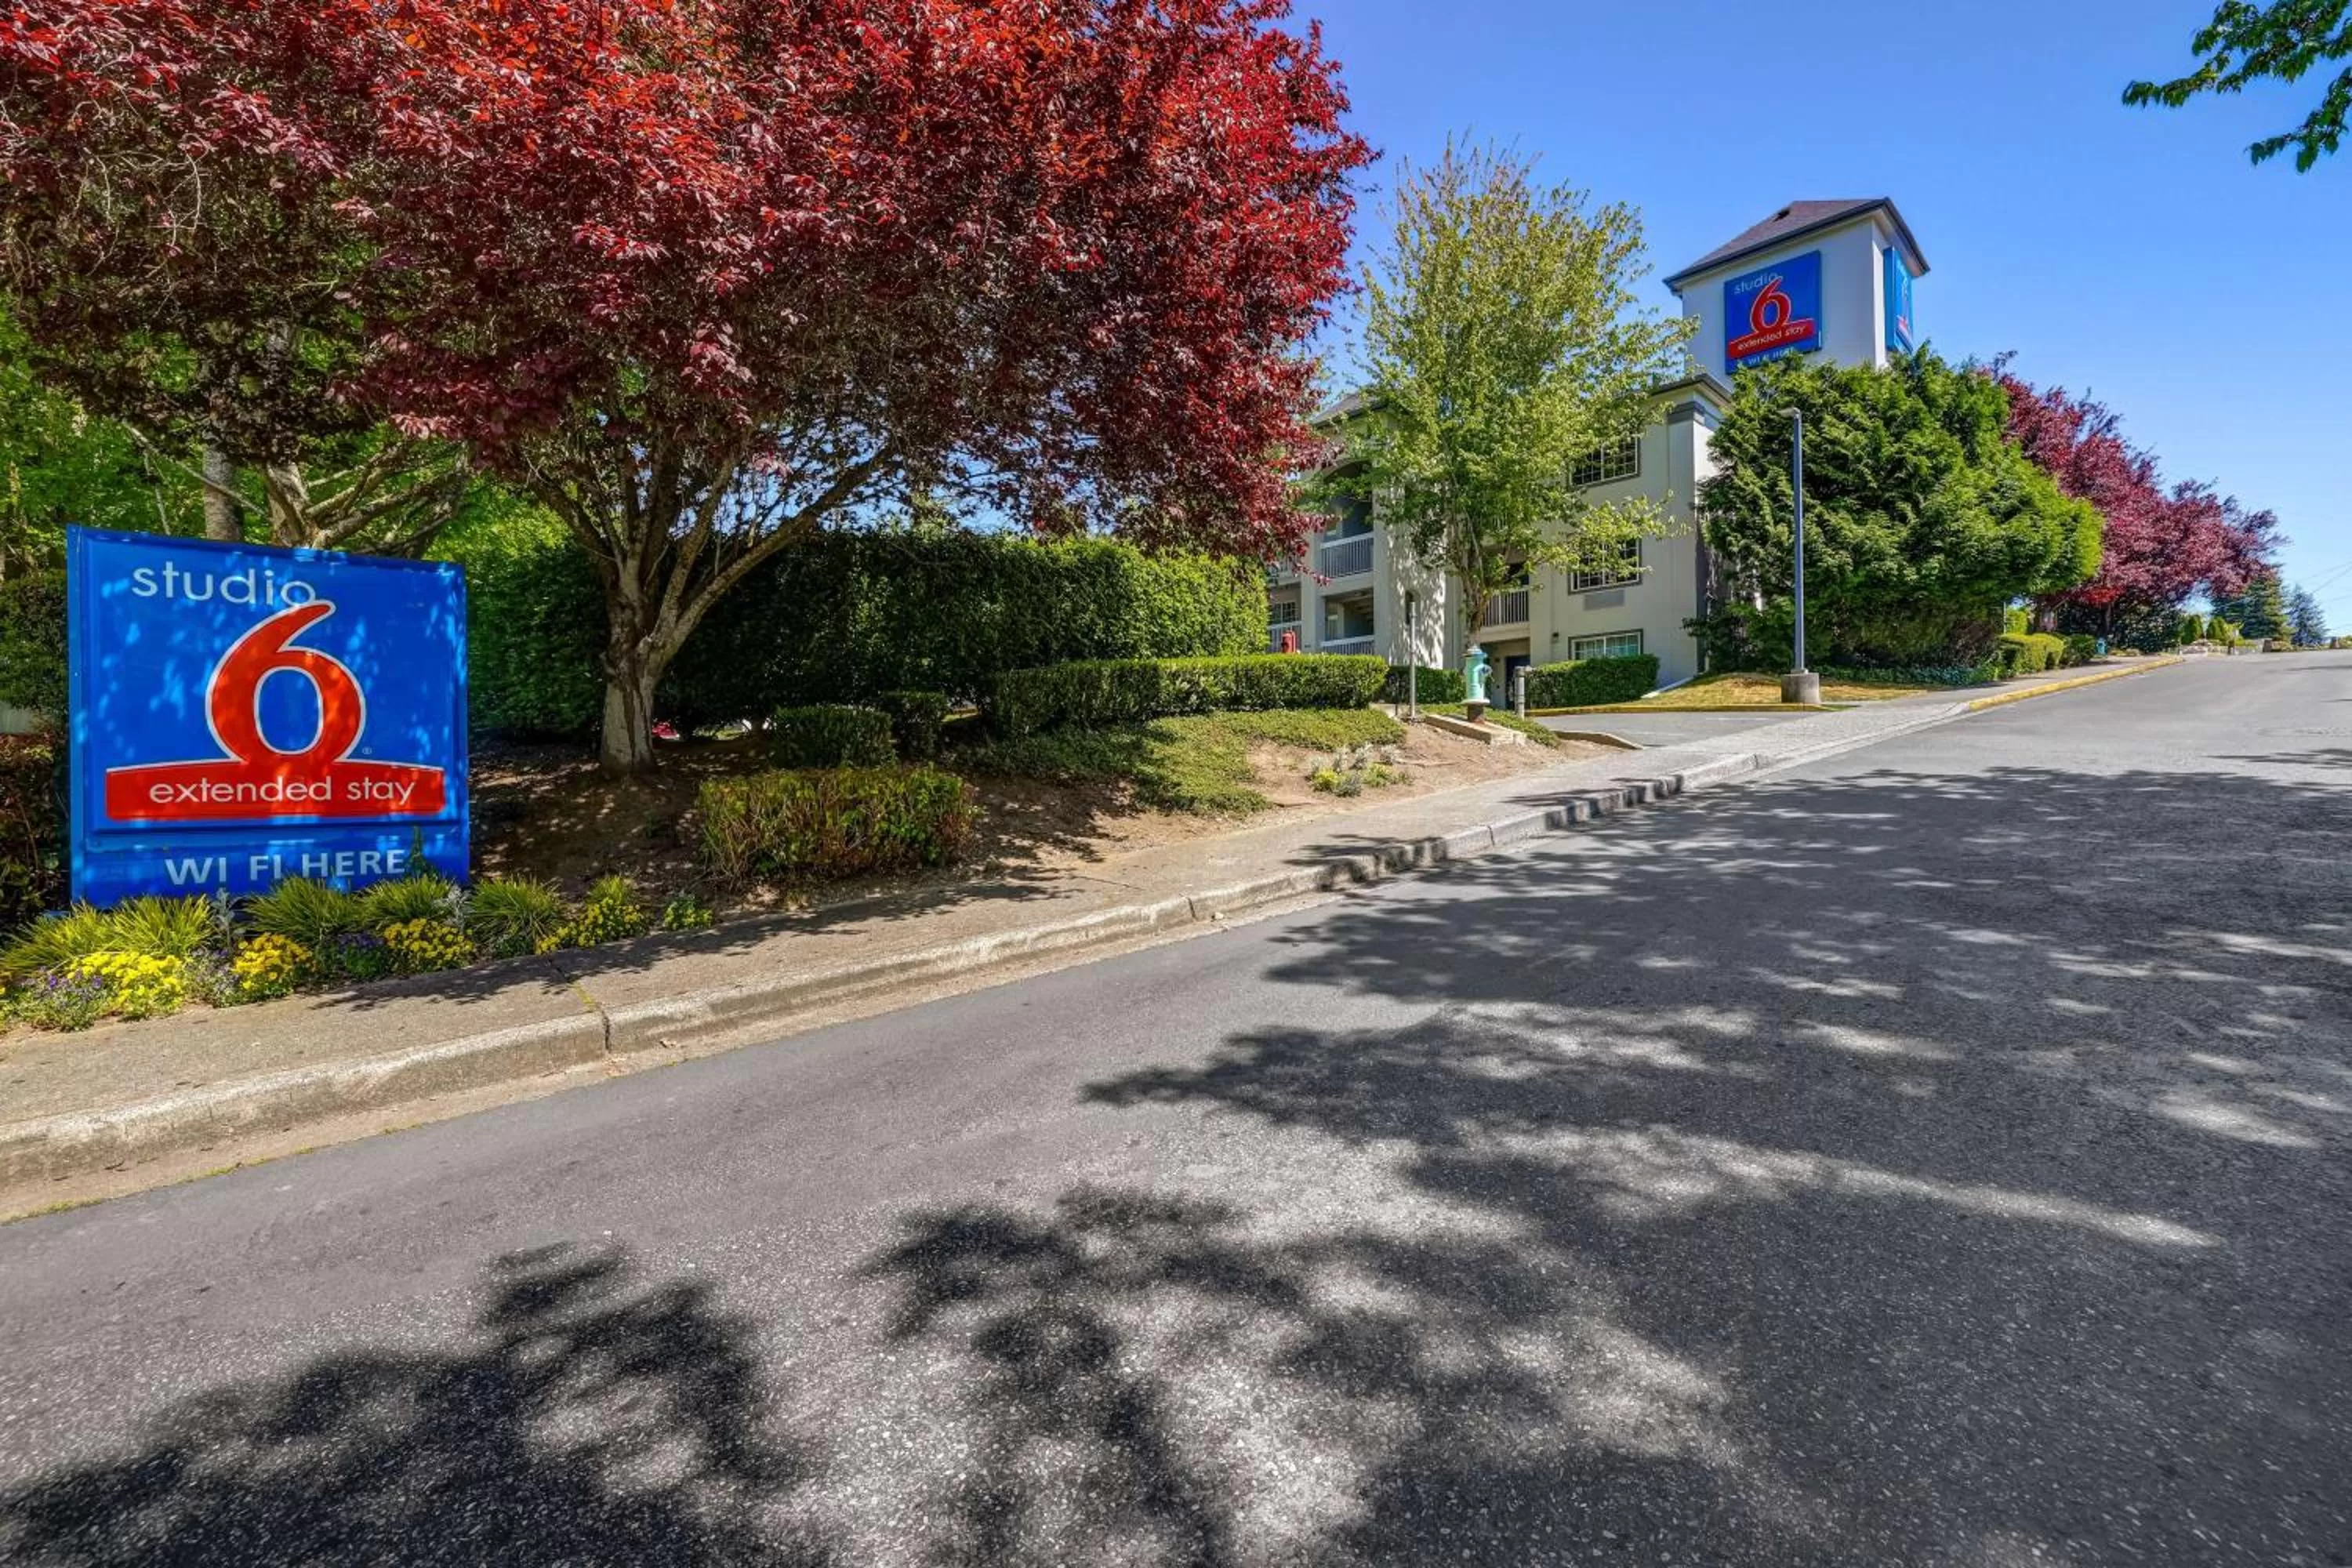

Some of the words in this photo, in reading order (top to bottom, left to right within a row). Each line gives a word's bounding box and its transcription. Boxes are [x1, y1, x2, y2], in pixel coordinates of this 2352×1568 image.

[1733, 272, 1779, 295] studio
[1750, 275, 1791, 333] 6
[1737, 329, 1782, 351] extended
[1784, 325, 1807, 337] stay
[131, 561, 316, 607] studio
[205, 599, 366, 764] 6
[149, 775, 332, 804] extended
[346, 775, 416, 806] stay
[165, 856, 227, 886] WI
[249, 854, 282, 880] FI
[302, 849, 406, 879] HERE
